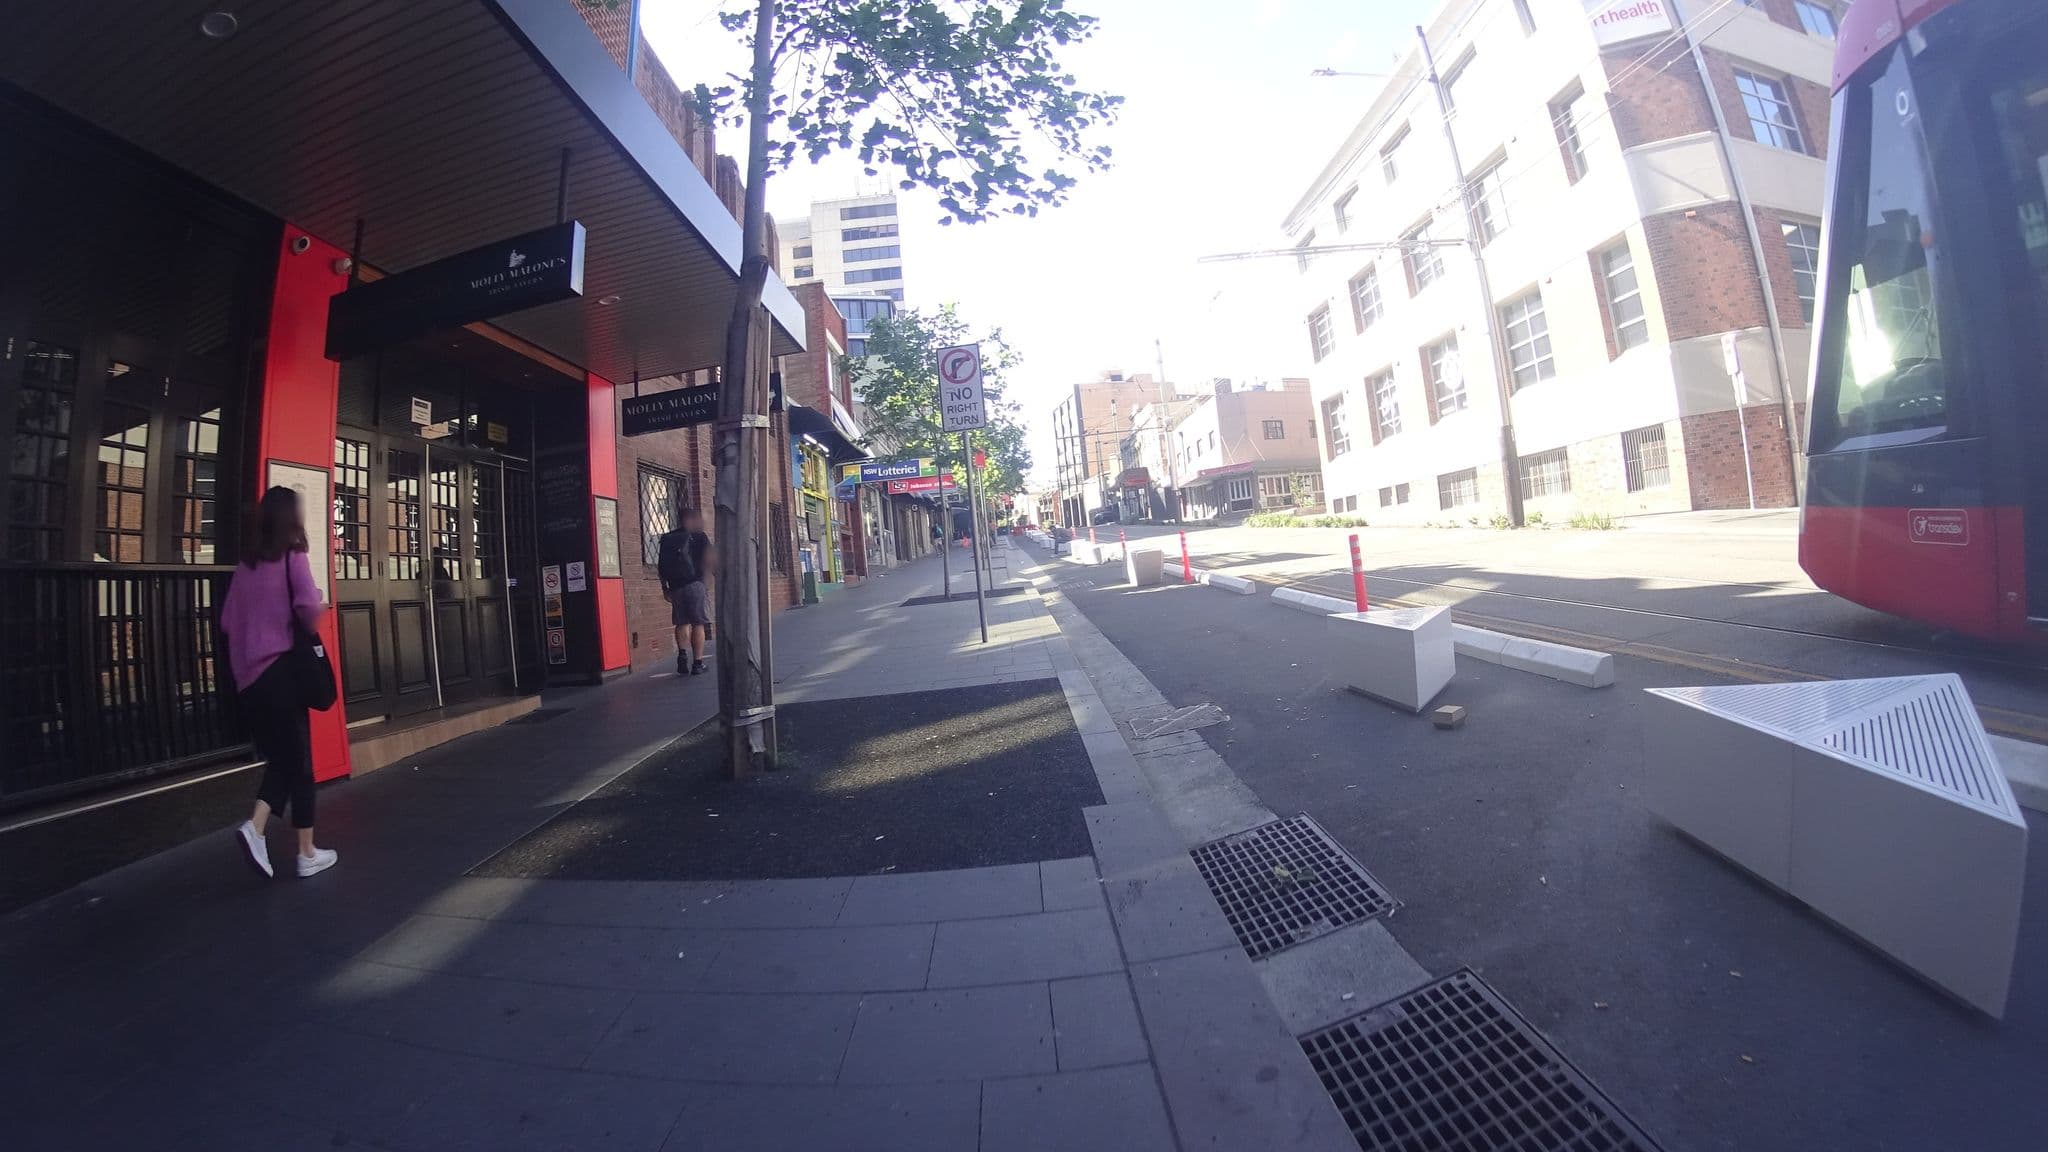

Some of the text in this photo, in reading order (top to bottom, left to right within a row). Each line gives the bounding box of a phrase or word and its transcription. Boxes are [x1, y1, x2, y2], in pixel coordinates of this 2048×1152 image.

[1607, 0, 1659, 23] health
[950, 387, 973, 401] NO
[625, 402, 663, 416] MOLLY
[947, 402, 978, 414] RIGHT
[950, 414, 980, 425] TURN
[863, 464, 917, 477] NSW Lotteries
